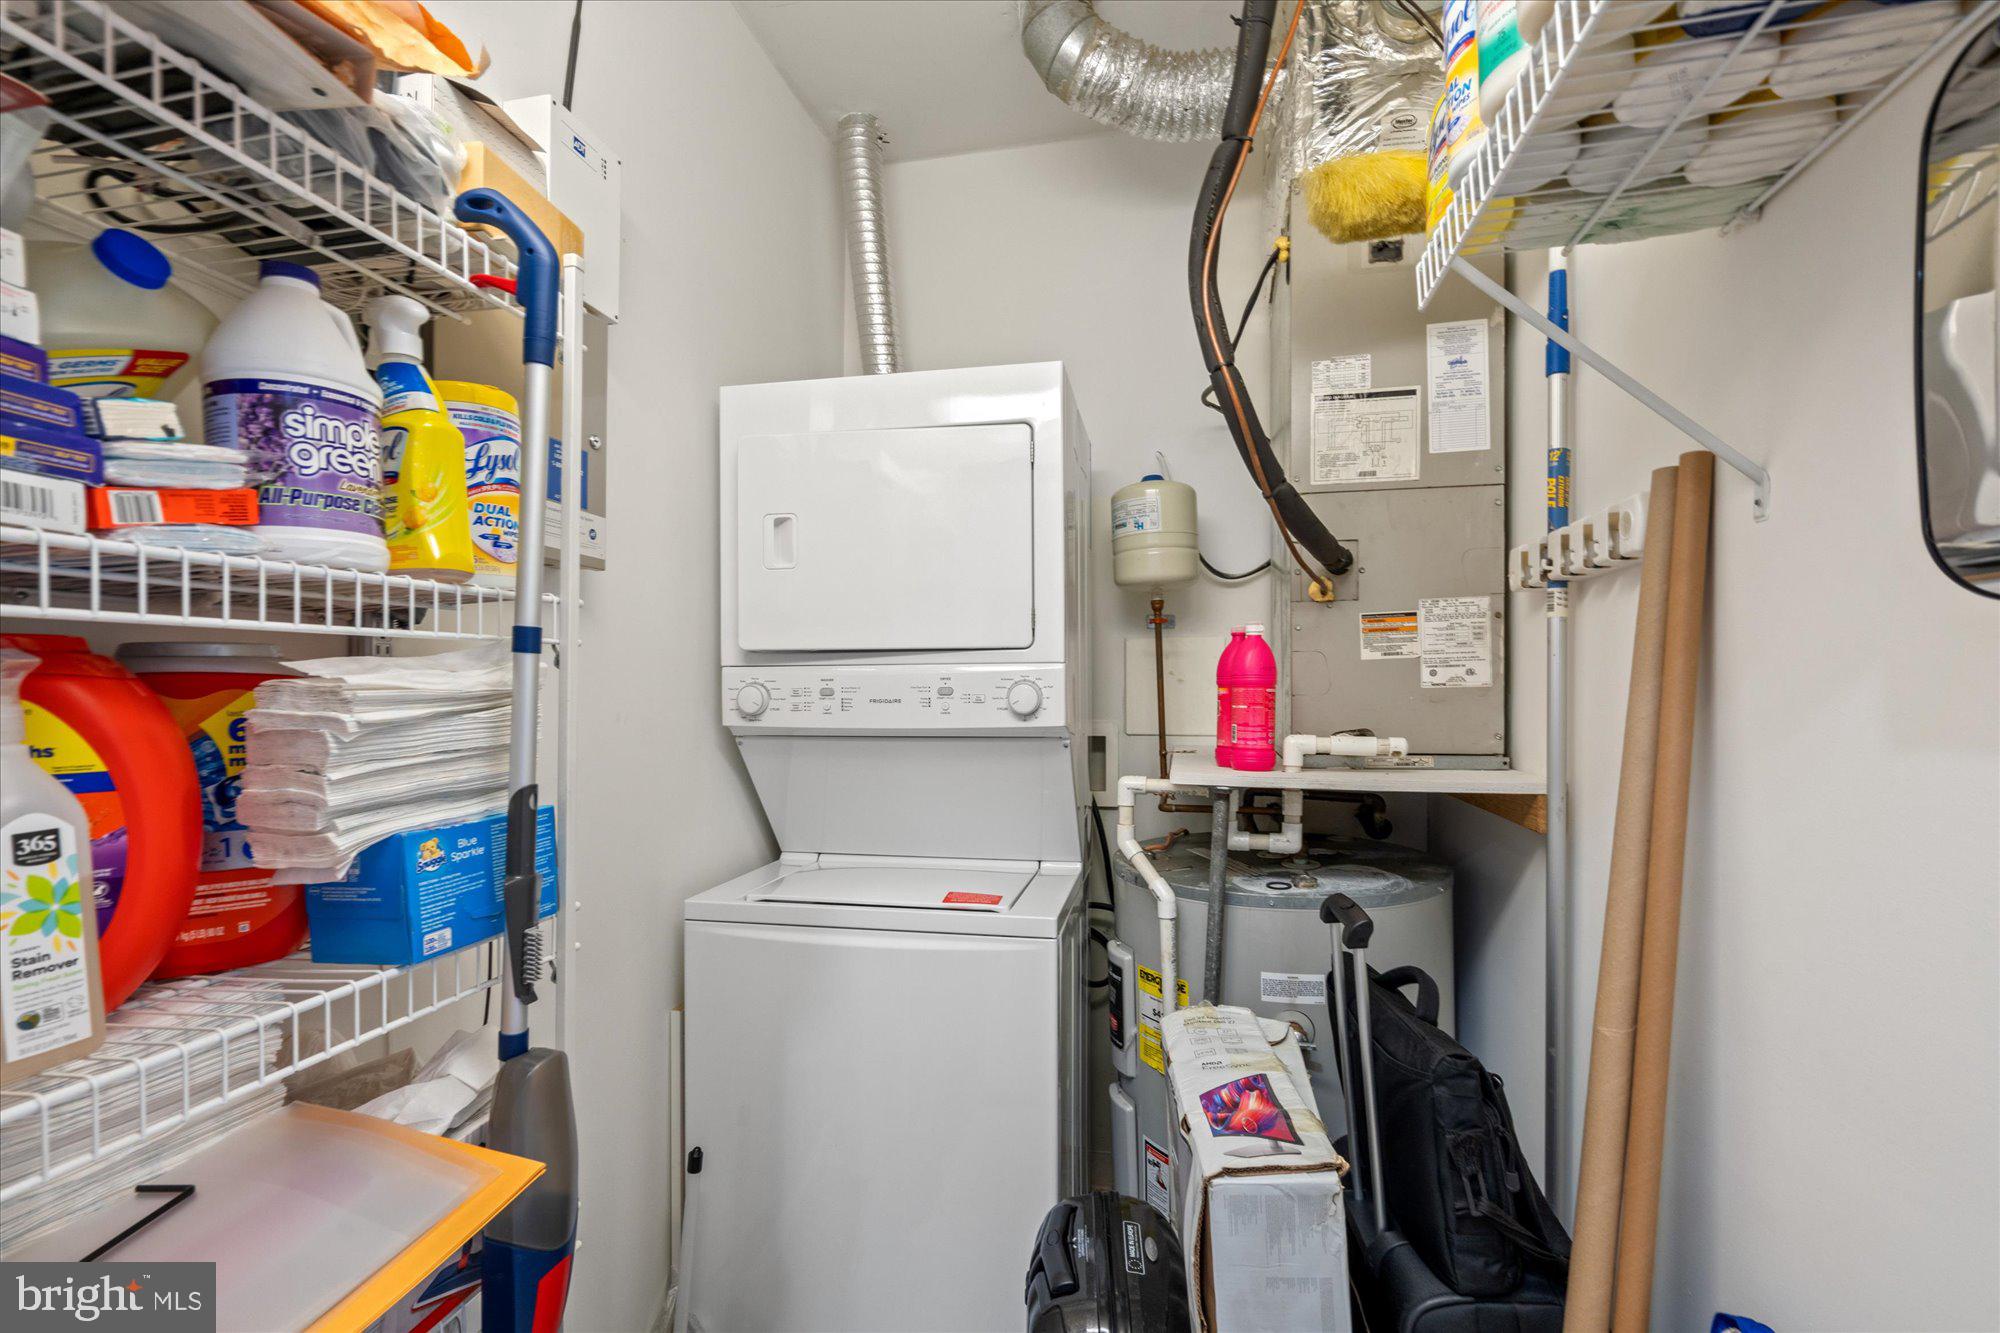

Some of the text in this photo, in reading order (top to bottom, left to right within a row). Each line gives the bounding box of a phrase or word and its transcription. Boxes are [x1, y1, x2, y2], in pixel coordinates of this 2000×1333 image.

[284, 404, 381, 453] simple
[290, 441, 381, 480] green
[466, 442, 519, 482] Lysol
[260, 487, 361, 513] All-Purpose
[473, 502, 511, 517] DUAL
[472, 517, 519, 530] ACTION
[17, 834, 58, 856] 365
[457, 837, 478, 849] Blue
[451, 846, 485, 863] Sparkle
[11, 952, 51, 969] Stain
[12, 957, 79, 982] Remover
